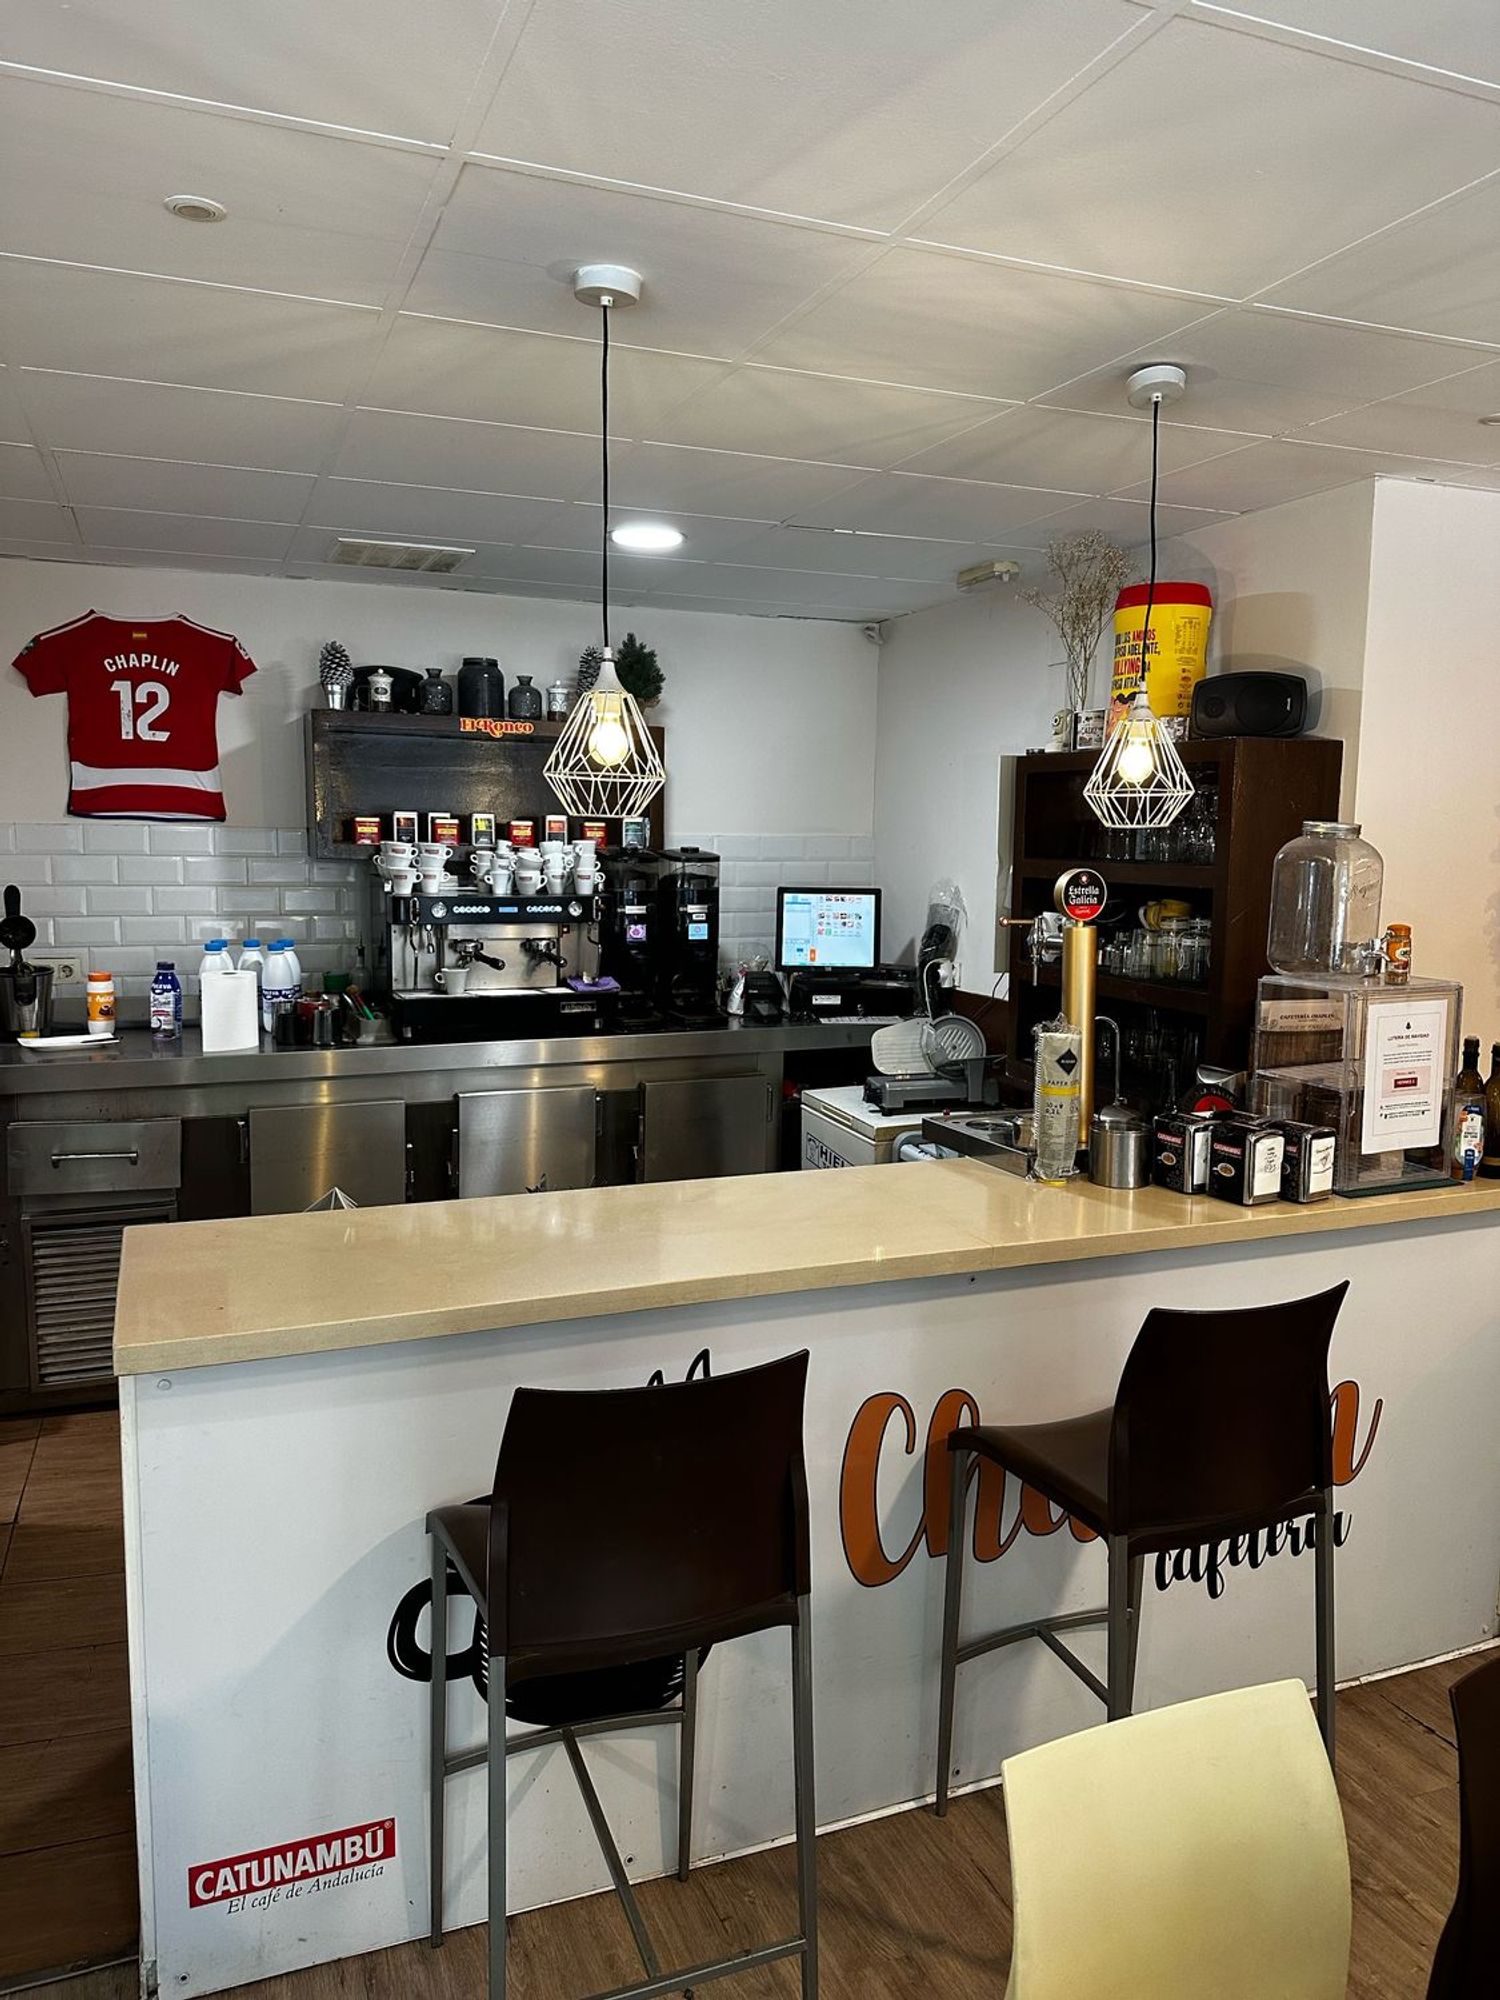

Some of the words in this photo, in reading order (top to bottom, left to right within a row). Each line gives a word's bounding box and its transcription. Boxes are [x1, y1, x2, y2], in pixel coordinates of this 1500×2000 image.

[1128, 641, 1161, 656] ADELNTE,
[103, 652, 180, 677] CHAPLIN
[109, 680, 171, 742] 12
[1068, 885, 1100, 895] Estrella
[1069, 895, 1098, 905] Galicia
[194, 1826, 385, 1900] CATUNAMBÚ
[226, 1897, 246, 1914] El
[250, 1886, 281, 1910] café
[285, 1882, 303, 1900] de
[307, 1862, 385, 1895] Andalucía
